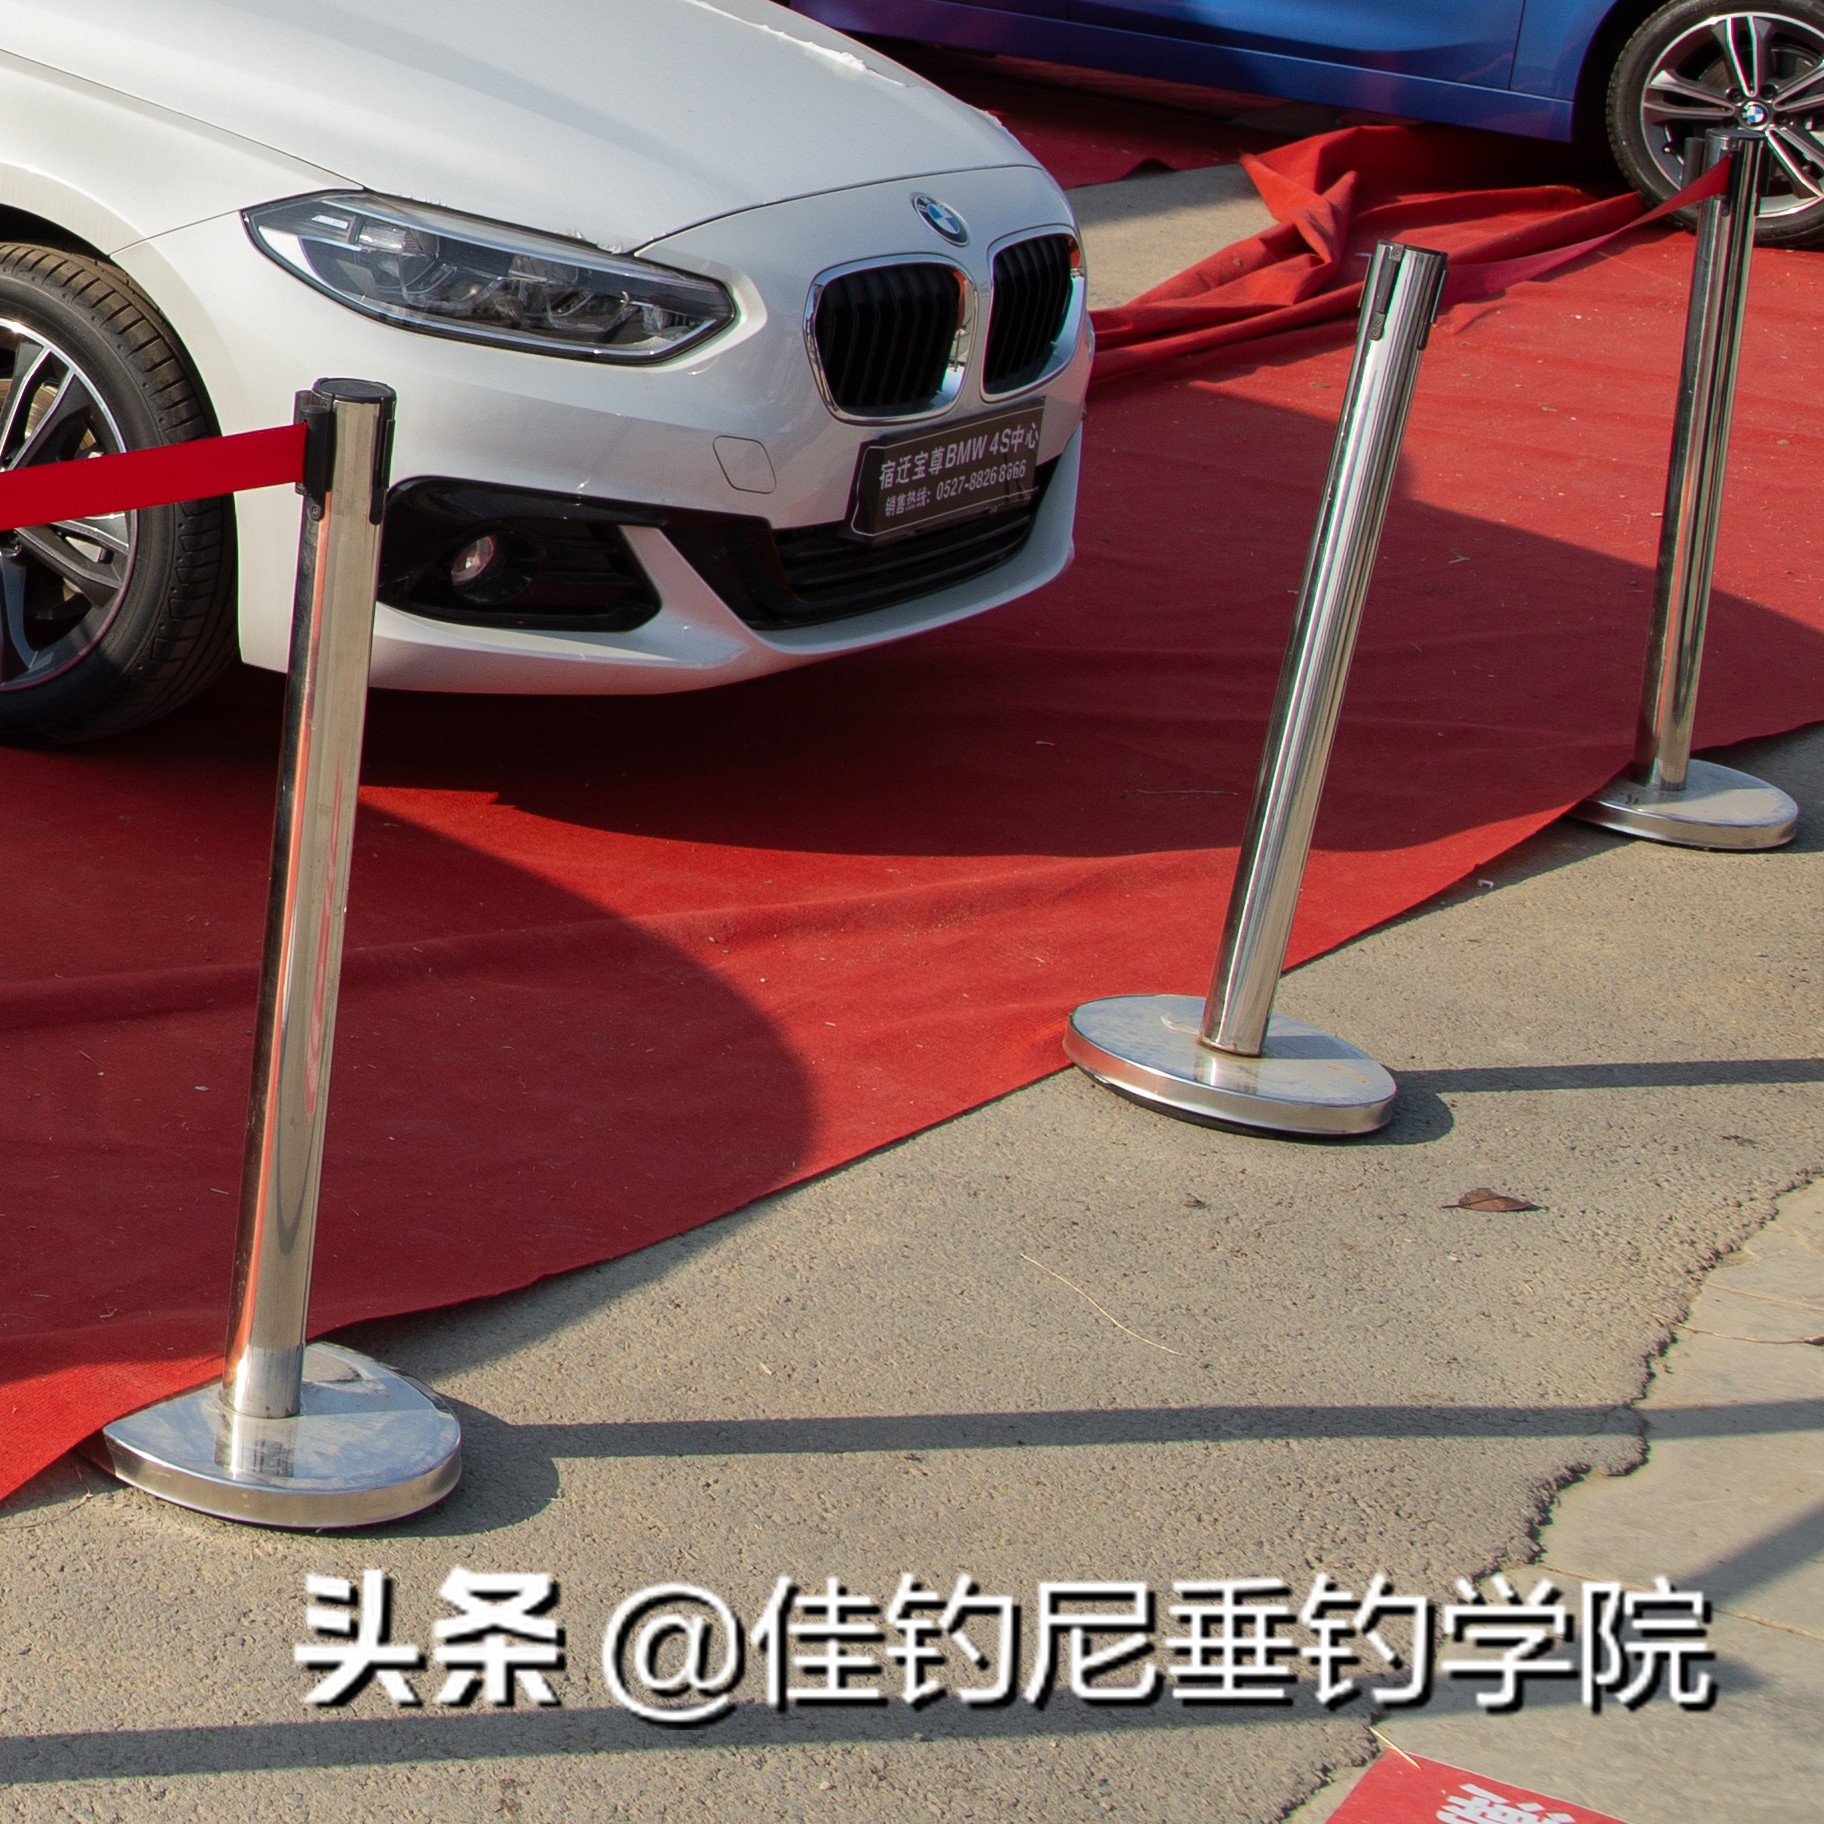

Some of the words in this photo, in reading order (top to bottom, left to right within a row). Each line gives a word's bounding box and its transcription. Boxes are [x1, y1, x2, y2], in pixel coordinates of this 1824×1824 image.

[879, 434, 989, 491] 宿迁宝尊BMW
[989, 421, 1040, 456] 4S中心
[936, 466, 997, 502] 0527-8826
